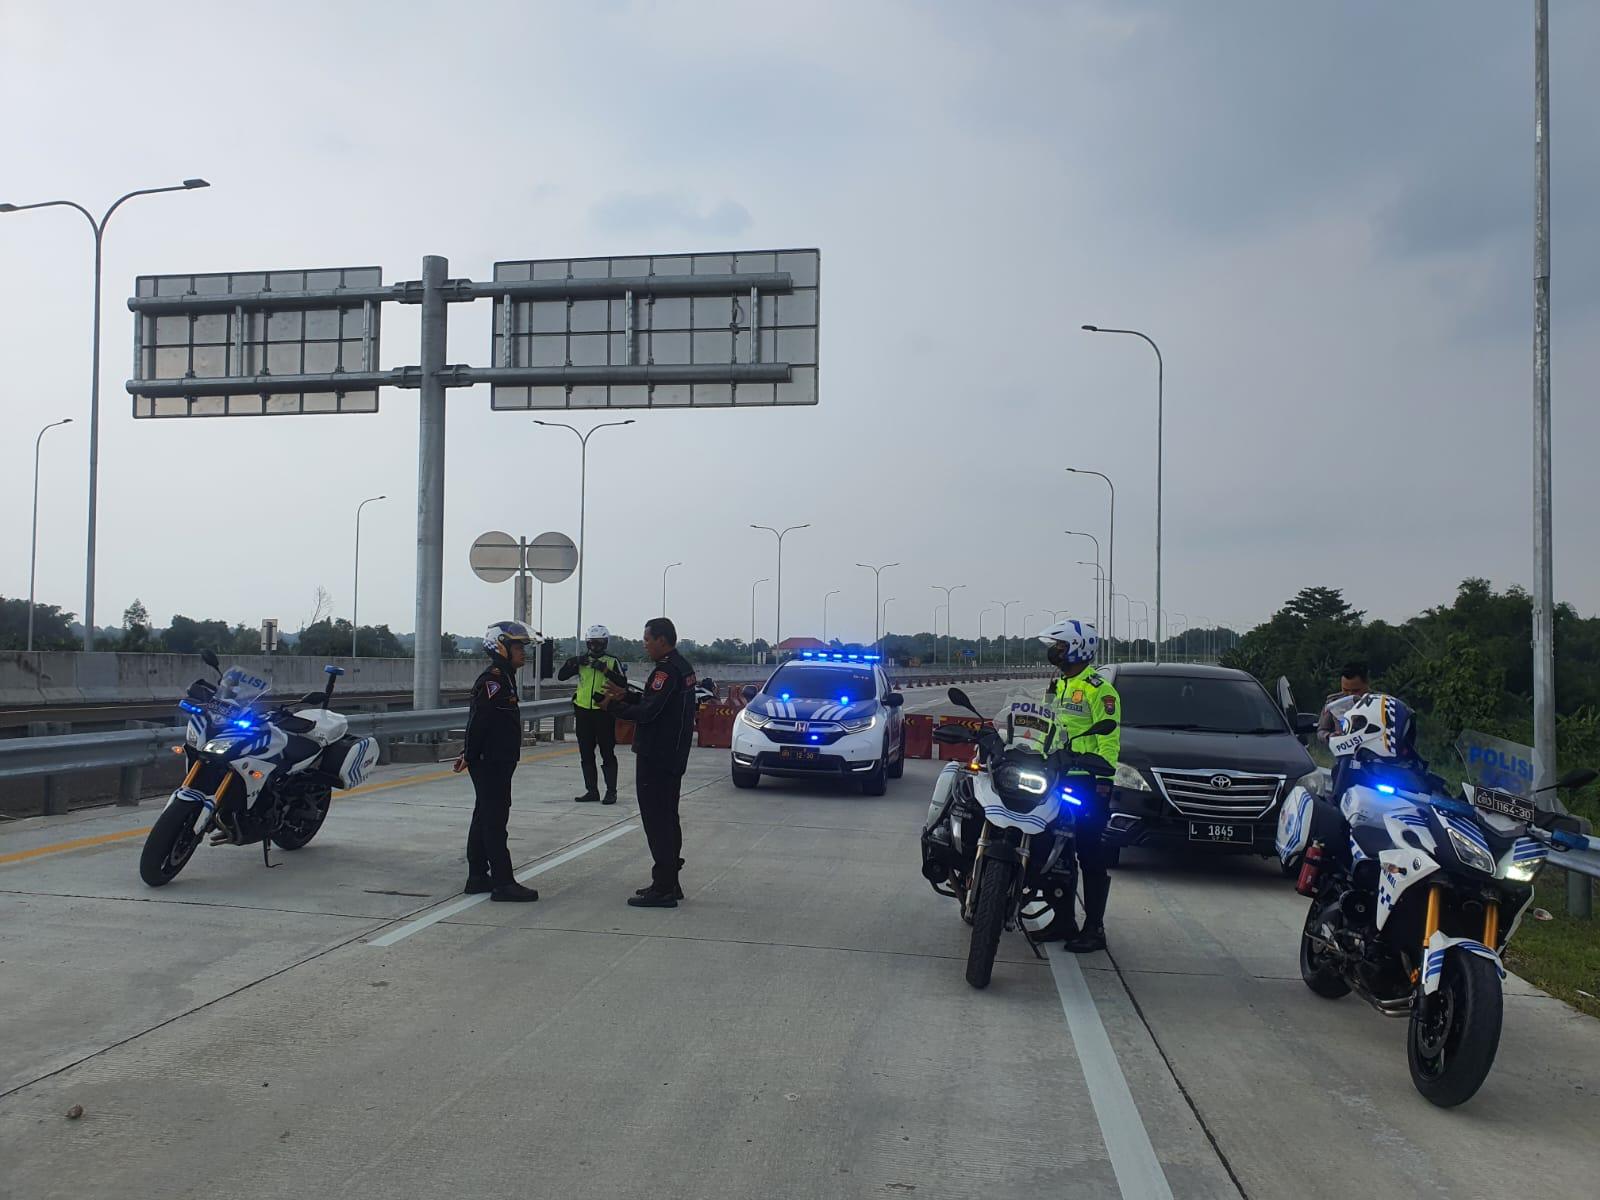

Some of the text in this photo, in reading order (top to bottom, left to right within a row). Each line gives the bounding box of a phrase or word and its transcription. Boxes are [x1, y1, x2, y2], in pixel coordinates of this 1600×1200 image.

[226, 670, 267, 689] LISI
[1011, 703, 1056, 719] POLISI
[1336, 735, 1364, 751] POLISI
[1468, 746, 1534, 781] POLISI
[1191, 823, 1234, 837] L 1845
